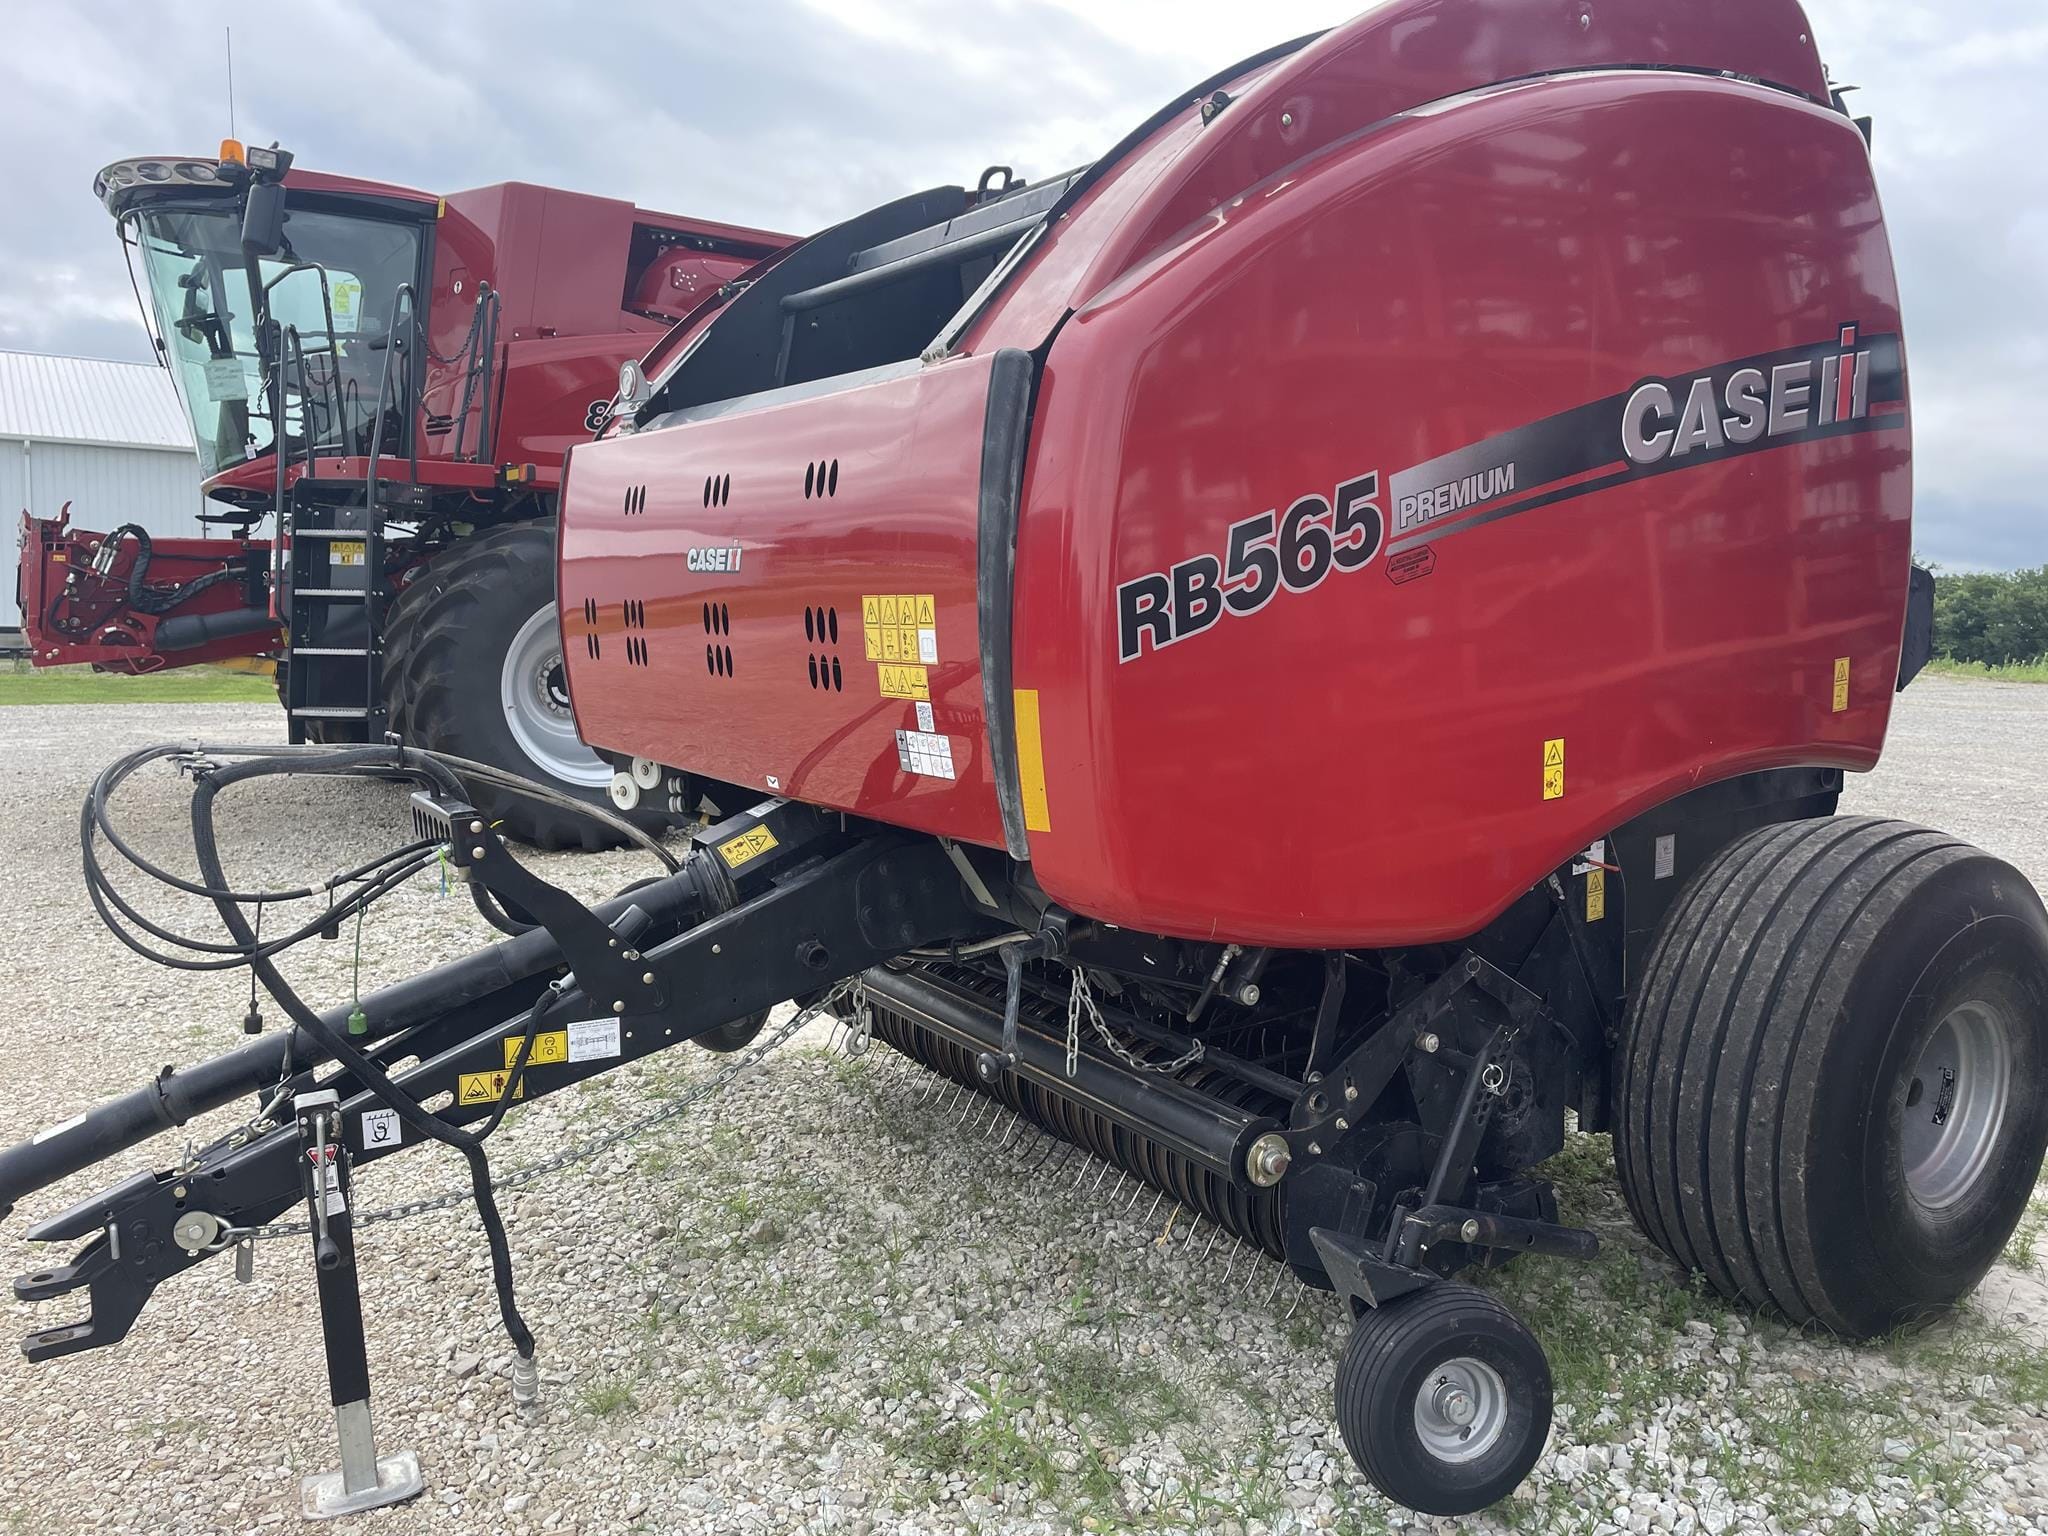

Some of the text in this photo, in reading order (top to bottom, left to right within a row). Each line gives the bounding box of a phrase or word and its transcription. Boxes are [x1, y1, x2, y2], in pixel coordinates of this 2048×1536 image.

[1621, 359, 1812, 464] CASE
[1399, 463, 1516, 528] PREMIUM
[687, 547, 727, 572] CASE
[1116, 470, 1384, 664] RB565
